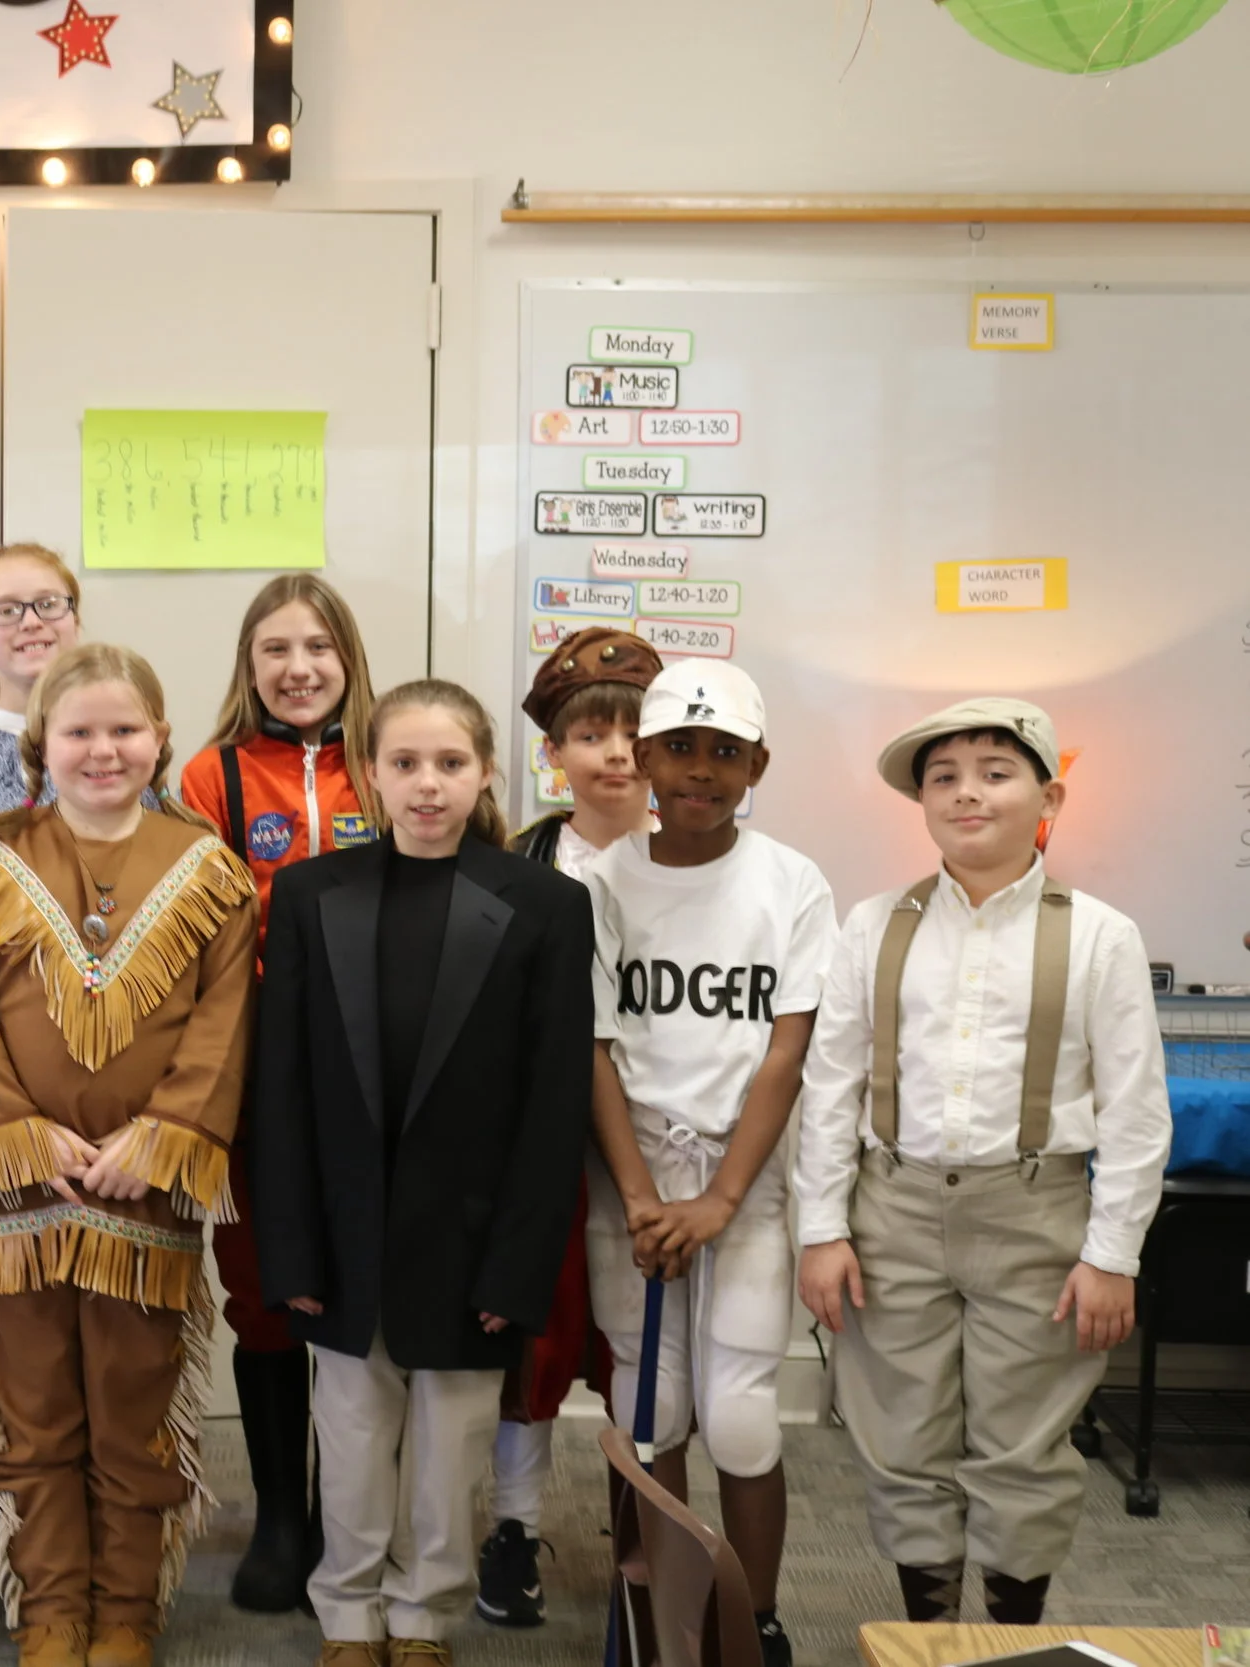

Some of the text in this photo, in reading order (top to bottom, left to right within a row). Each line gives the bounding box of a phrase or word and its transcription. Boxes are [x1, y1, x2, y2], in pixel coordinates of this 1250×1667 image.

[982, 306, 1040, 318] MEMORY
[982, 327, 1018, 339] VERSE
[606, 333, 674, 359] Monday
[620, 371, 671, 390] Music
[578, 416, 608, 435] Art
[596, 461, 672, 484] Tuesday
[599, 499, 642, 517] Ensemble
[594, 547, 688, 572] Wednesday
[967, 568, 1041, 582] CHARACTER
[574, 588, 630, 610] Library
[649, 586, 728, 603] 12:40-1:20
[968, 591, 1009, 602] WORD
[650, 627, 719, 648] 1:40-2:20
[252, 827, 291, 845] NASA
